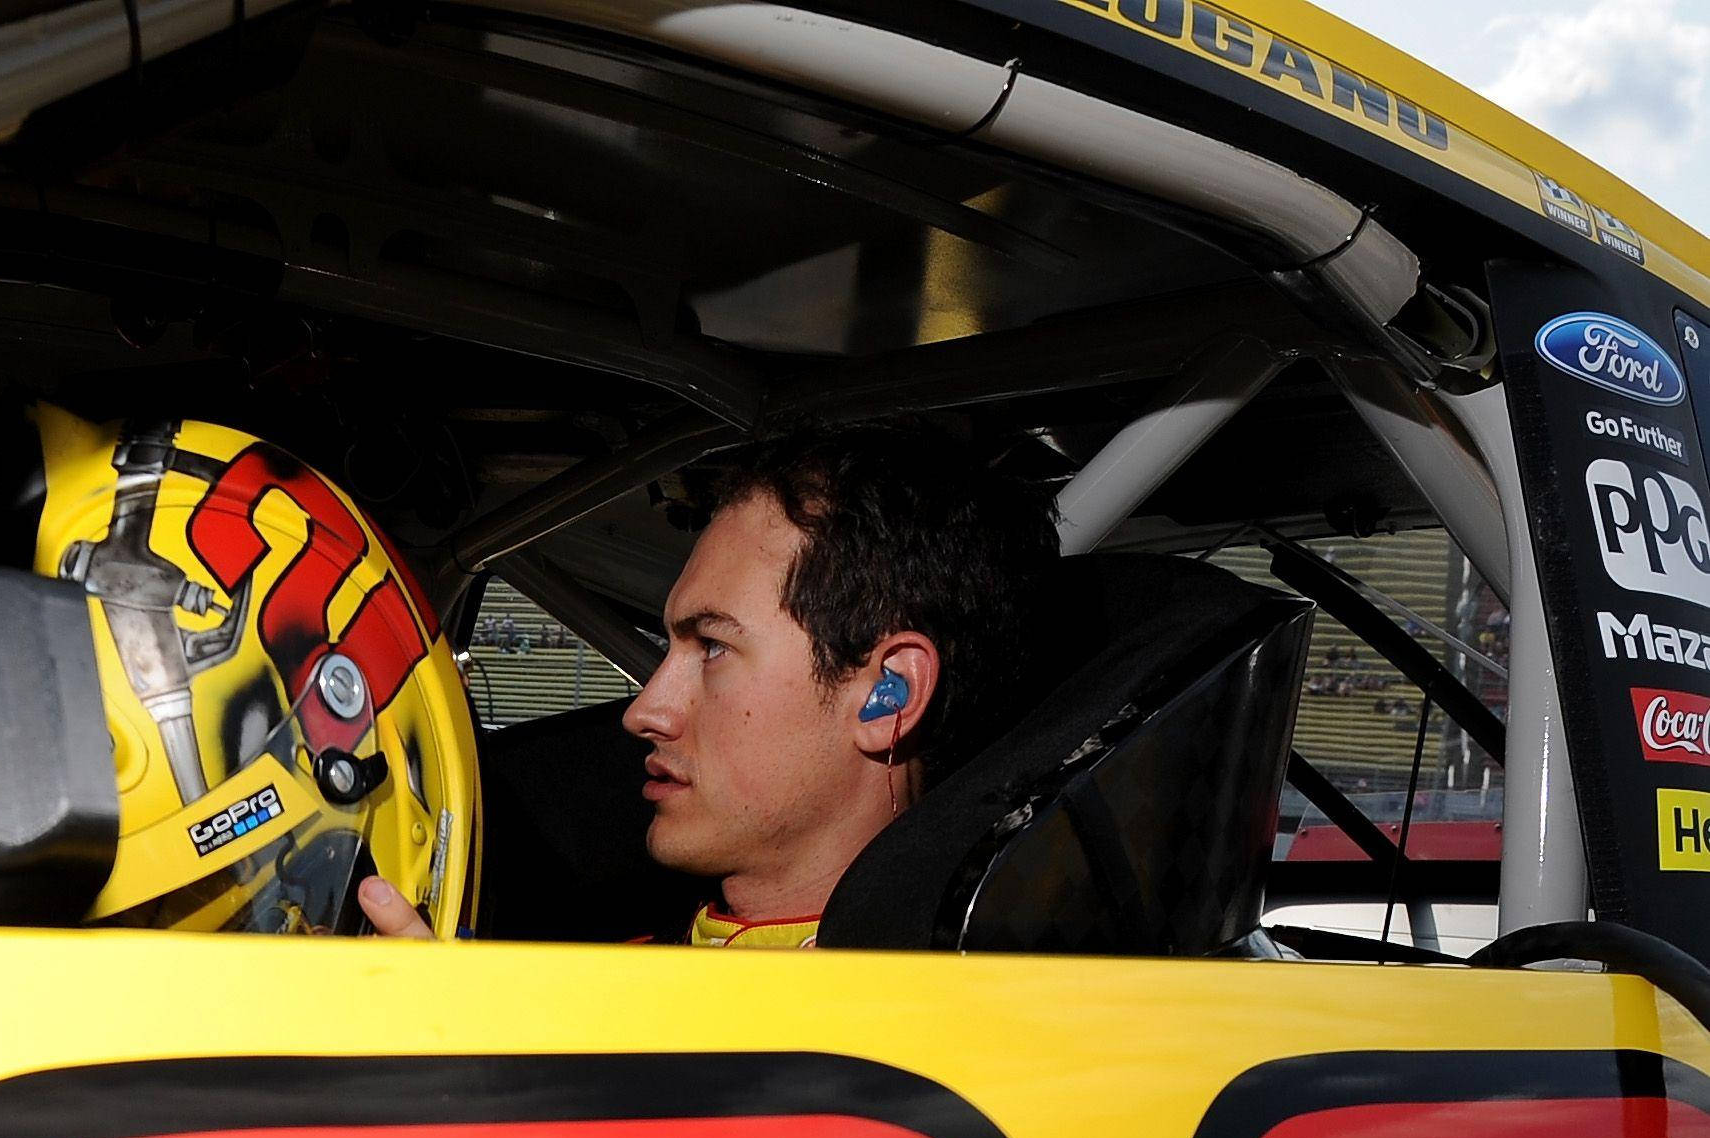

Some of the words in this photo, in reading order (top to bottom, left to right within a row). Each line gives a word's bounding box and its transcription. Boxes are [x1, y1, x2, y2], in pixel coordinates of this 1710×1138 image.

[1082, 0, 1449, 151] OGANO
[1546, 202, 1589, 233] WINNER
[1600, 230, 1641, 261] WINNER
[1578, 323, 1663, 393] Ford
[1586, 411, 1619, 437] Go
[1620, 416, 1683, 458] Further
[1642, 696, 1710, 756] Coca-
[190, 788, 277, 844] GoPro
